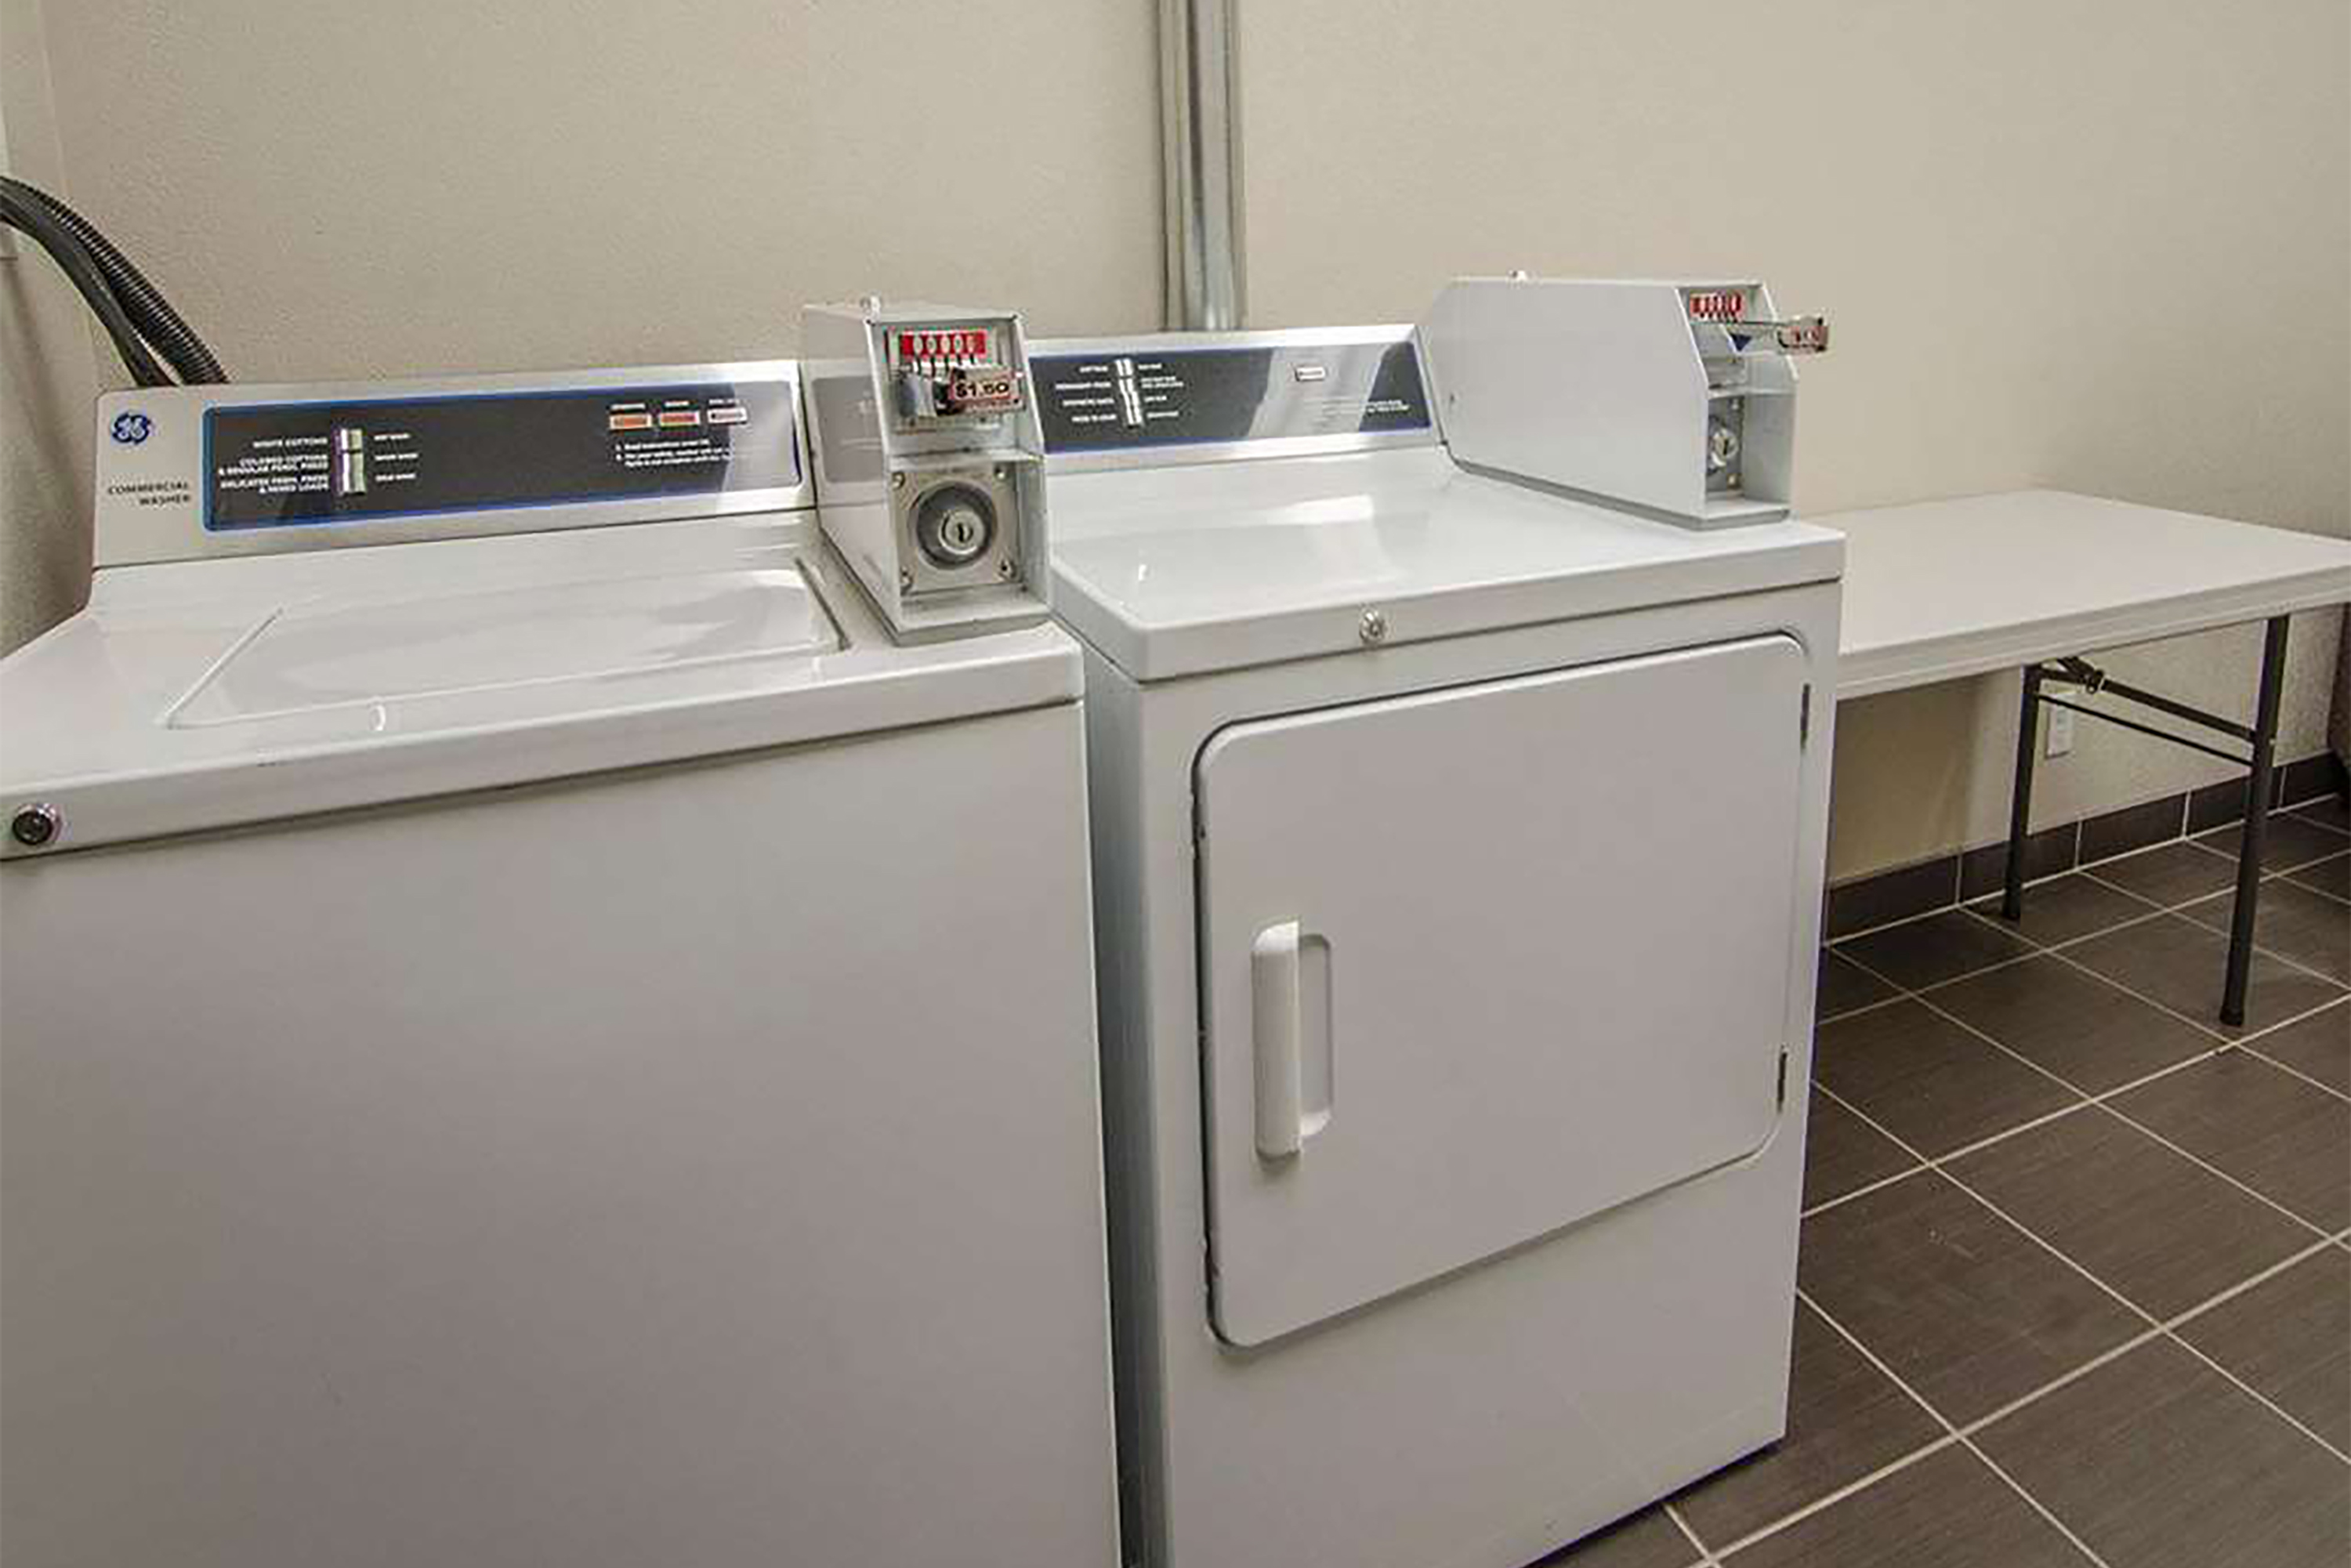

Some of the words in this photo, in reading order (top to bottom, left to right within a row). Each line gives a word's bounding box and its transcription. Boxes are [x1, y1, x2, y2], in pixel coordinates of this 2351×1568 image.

[956, 381, 1009, 398] $1.50
[108, 480, 188, 495] COMMERCIAL
[139, 493, 190, 507] WASHER
